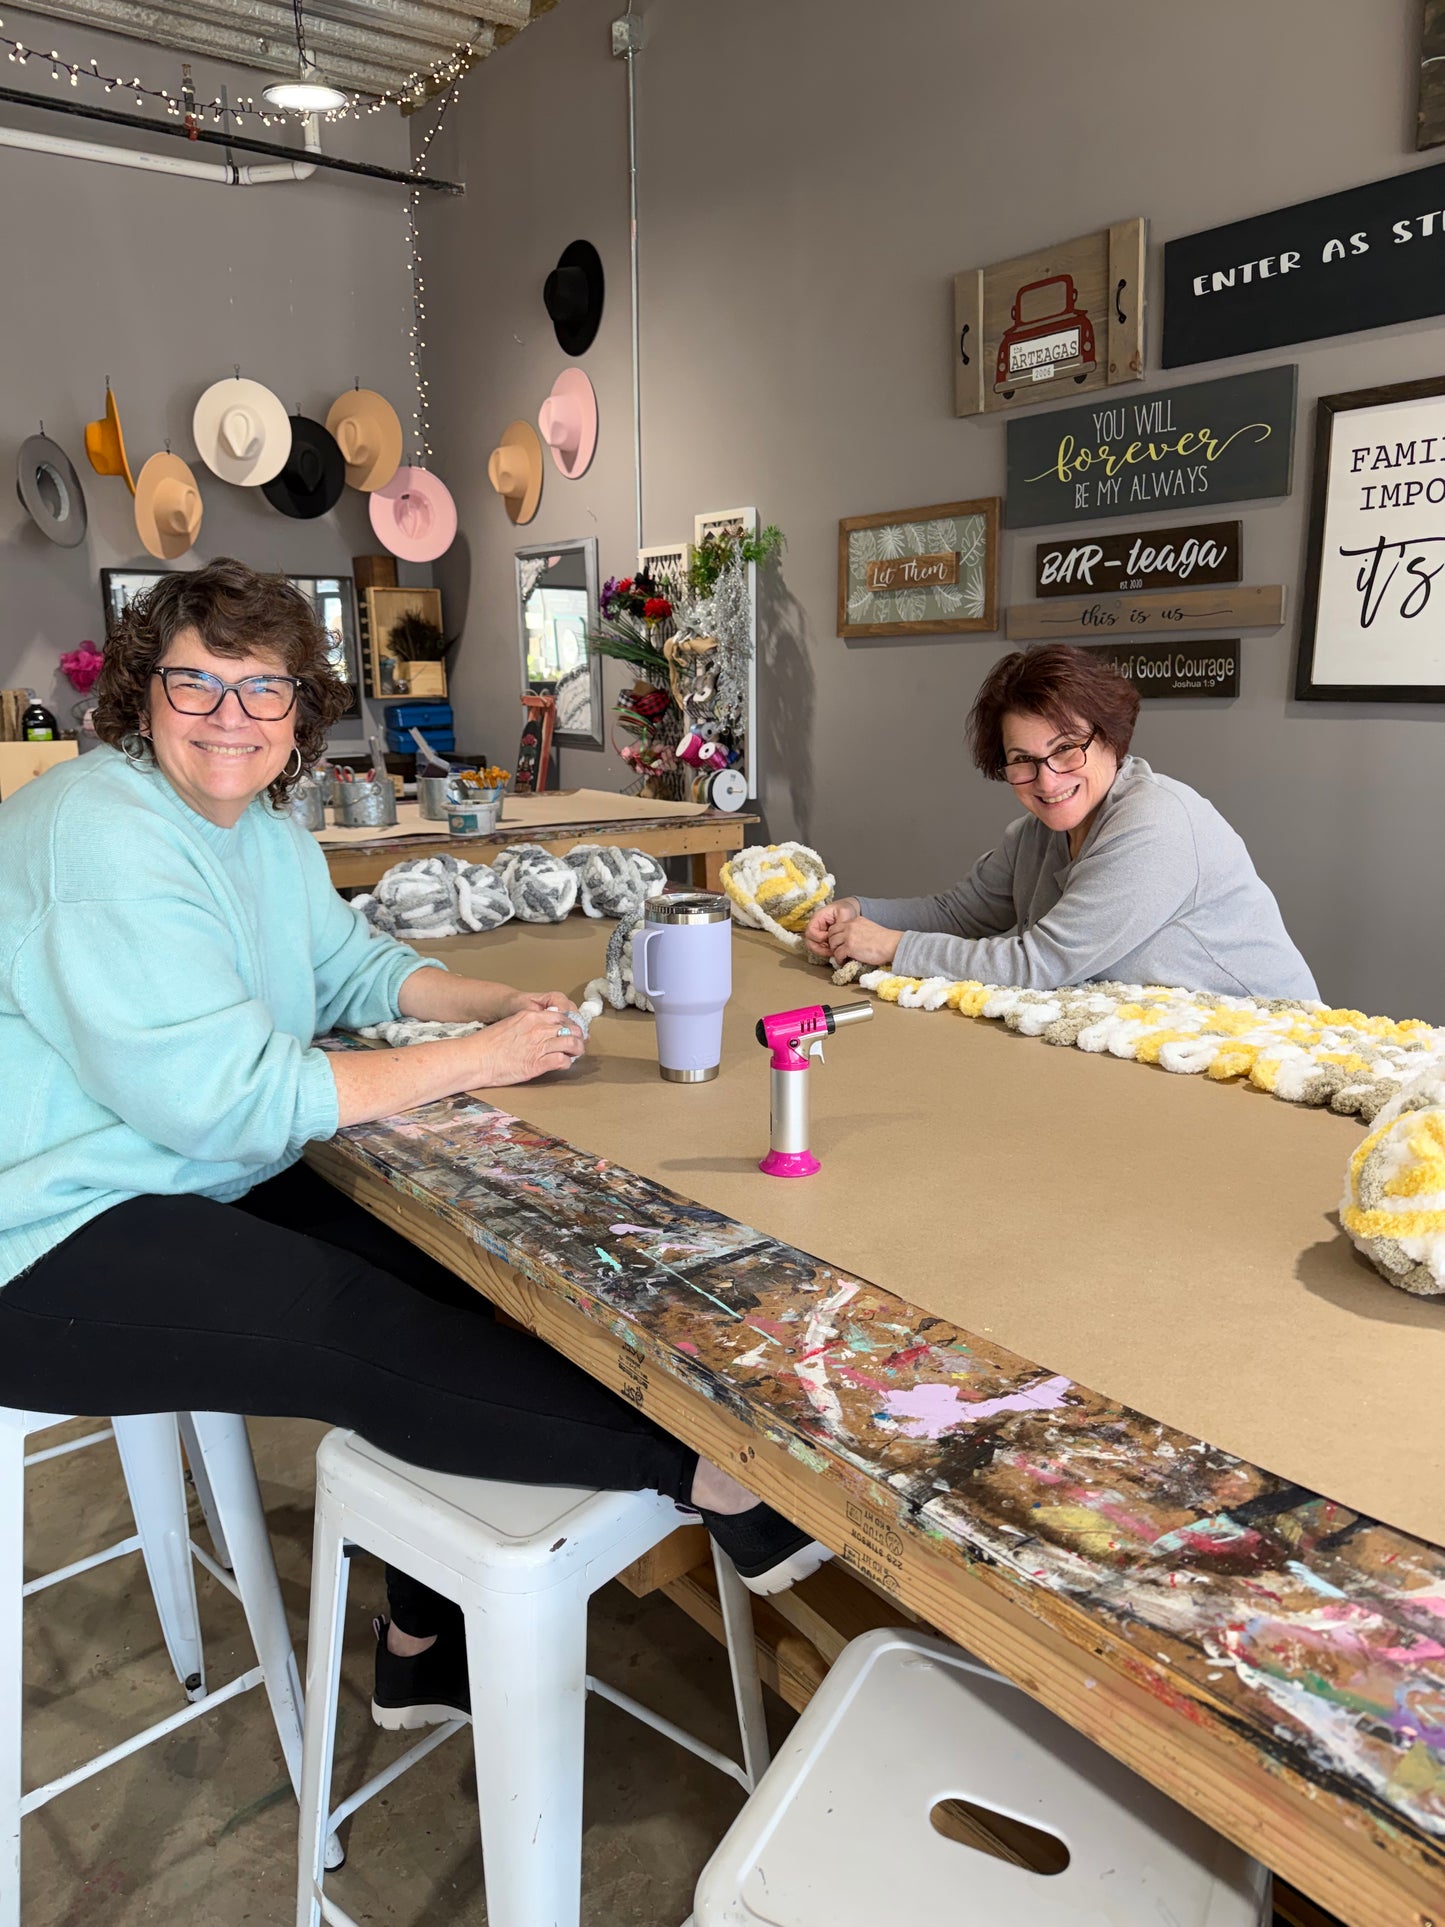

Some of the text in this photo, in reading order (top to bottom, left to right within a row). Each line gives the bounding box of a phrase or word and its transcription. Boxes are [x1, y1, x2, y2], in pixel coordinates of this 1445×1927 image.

[1193, 210, 1445, 296] ENTER AS ST
[1011, 340, 1078, 370] ARTEAGAS
[1092, 399, 1177, 443] YOU WILL
[1024, 423, 1272, 482] forever
[1350, 437, 1445, 473] FAMI
[1075, 465, 1208, 509] BE MY ALWAYS
[872, 559, 948, 588] Let Them
[1080, 604, 1185, 627] this is us
[1121, 655, 1135, 679] of
[1136, 654, 1172, 679] Good
[1175, 654, 1235, 682] Courage
[1172, 679, 1216, 689] Joshua 1:9
